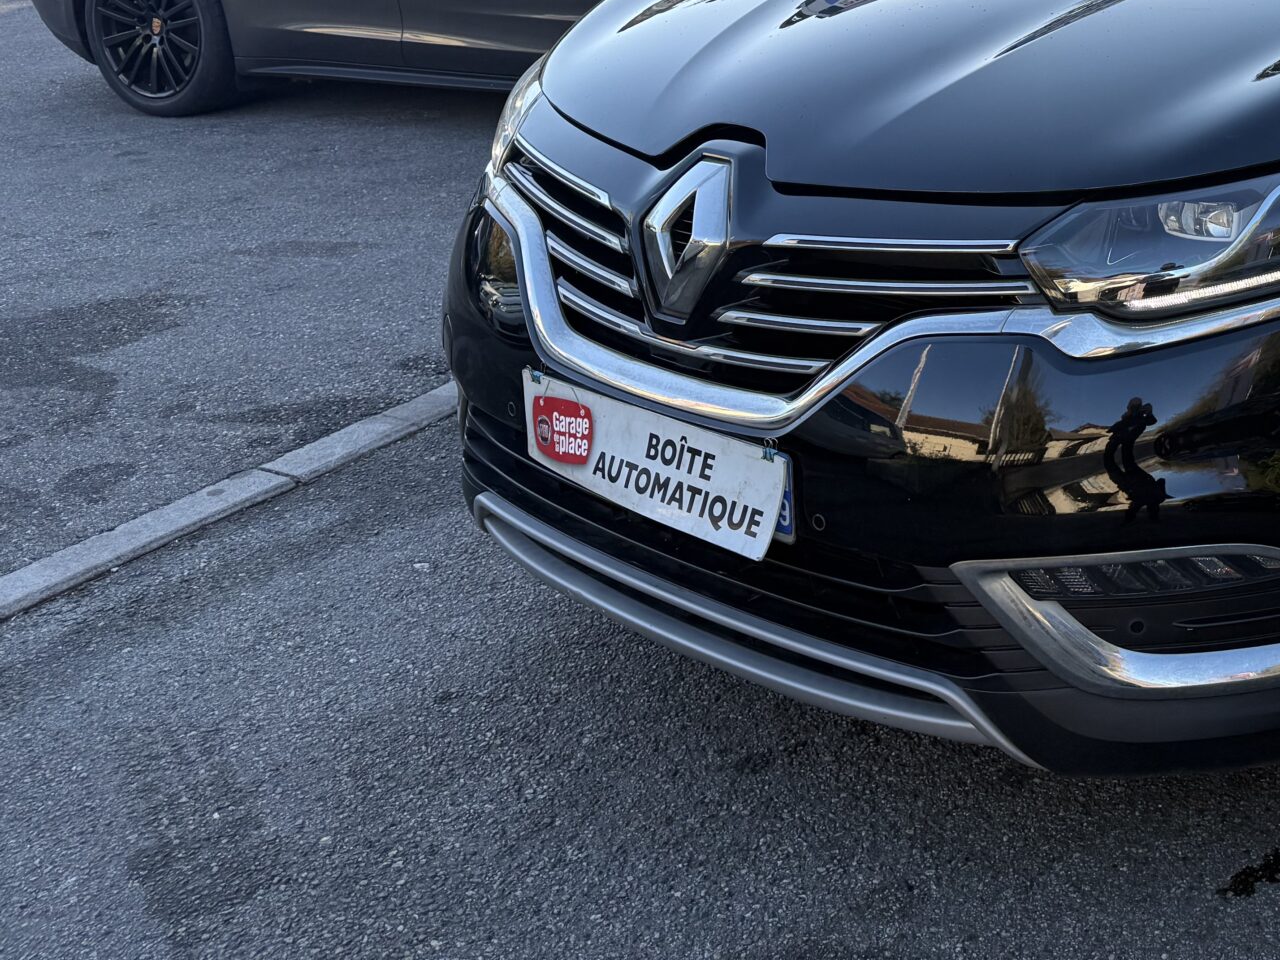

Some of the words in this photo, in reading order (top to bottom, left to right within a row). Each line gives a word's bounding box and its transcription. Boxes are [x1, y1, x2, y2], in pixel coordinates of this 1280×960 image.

[552, 411, 590, 437] Garage
[559, 433, 589, 457] place
[645, 432, 716, 481] BOÎTE
[592, 451, 764, 538] AUTOMATIQUE
